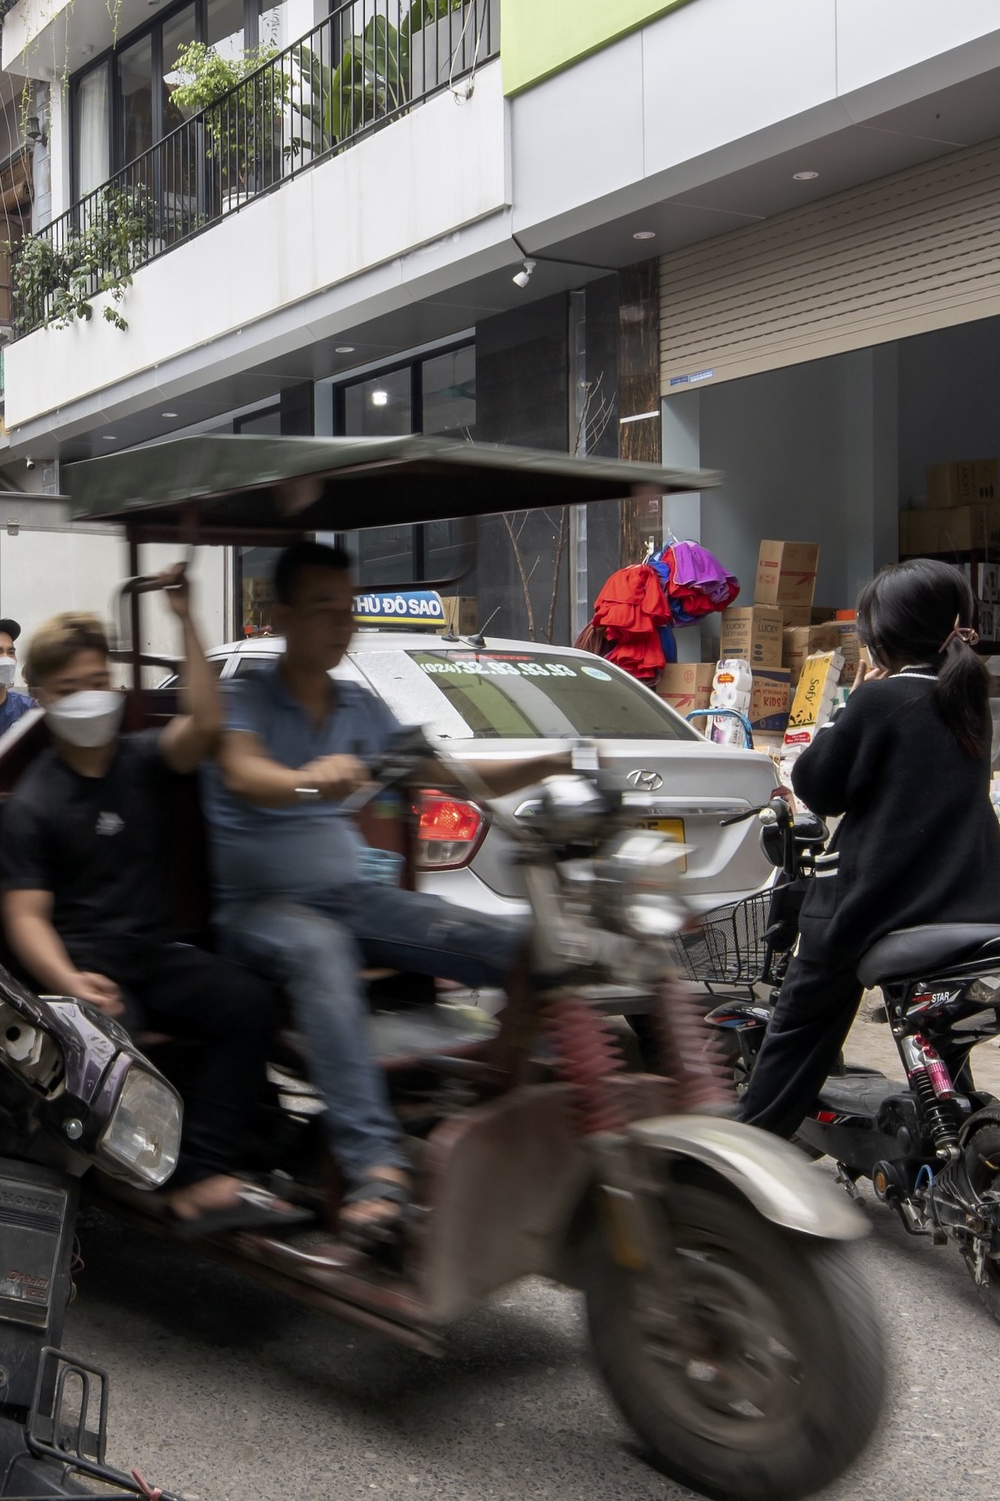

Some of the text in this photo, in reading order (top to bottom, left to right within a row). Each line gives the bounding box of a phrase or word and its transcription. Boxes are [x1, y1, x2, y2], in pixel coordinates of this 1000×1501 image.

[382, 595, 407, 614] ĐÔ
[408, 599, 441, 616] SAO
[931, 991, 950, 1003] STAR
